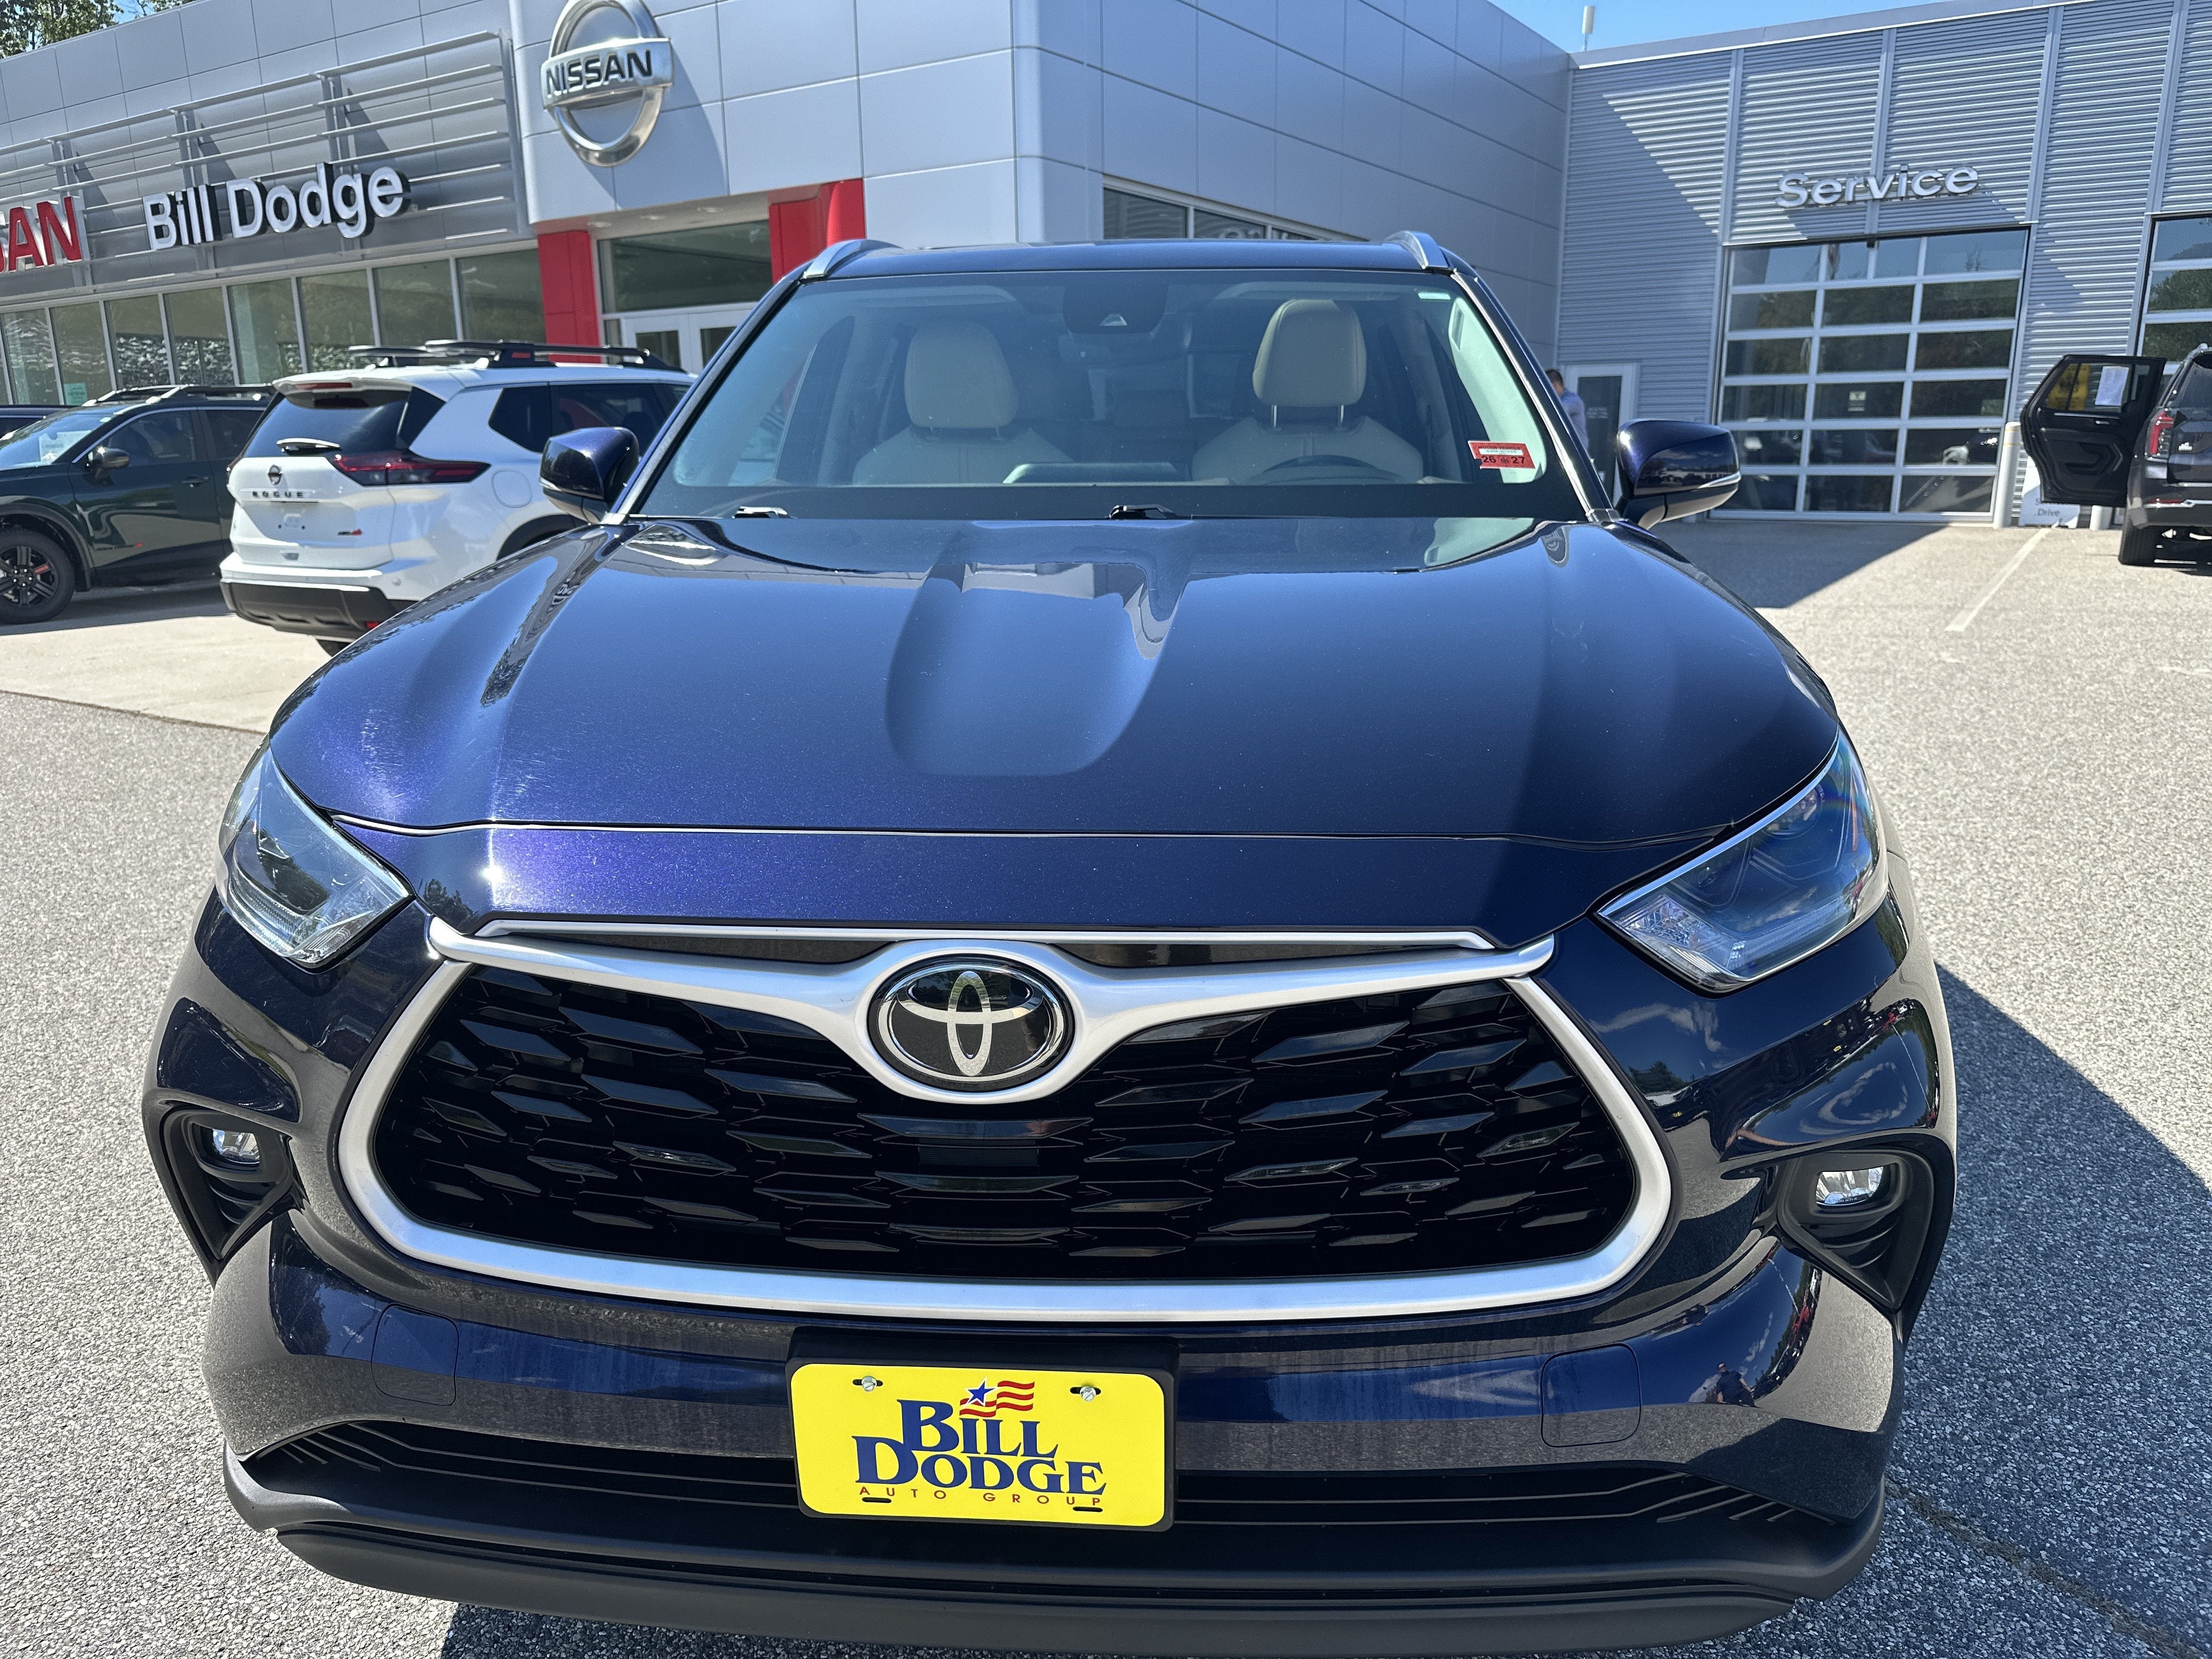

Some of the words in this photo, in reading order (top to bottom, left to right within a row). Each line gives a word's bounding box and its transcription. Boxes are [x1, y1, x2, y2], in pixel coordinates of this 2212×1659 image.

[546, 49, 652, 95] NISSAN
[143, 184, 215, 250] Bill
[226, 162, 404, 238] Dodge
[1775, 164, 1979, 207] Service
[0, 196, 82, 273] AN
[1511, 456, 1525, 464] 27
[2037, 507, 2061, 516] Drive
[896, 1399, 1059, 1458] BILL
[851, 1435, 1107, 1495] DODGE
[859, 1486, 947, 1499] AUTO
[983, 1492, 1101, 1506] GROUP
